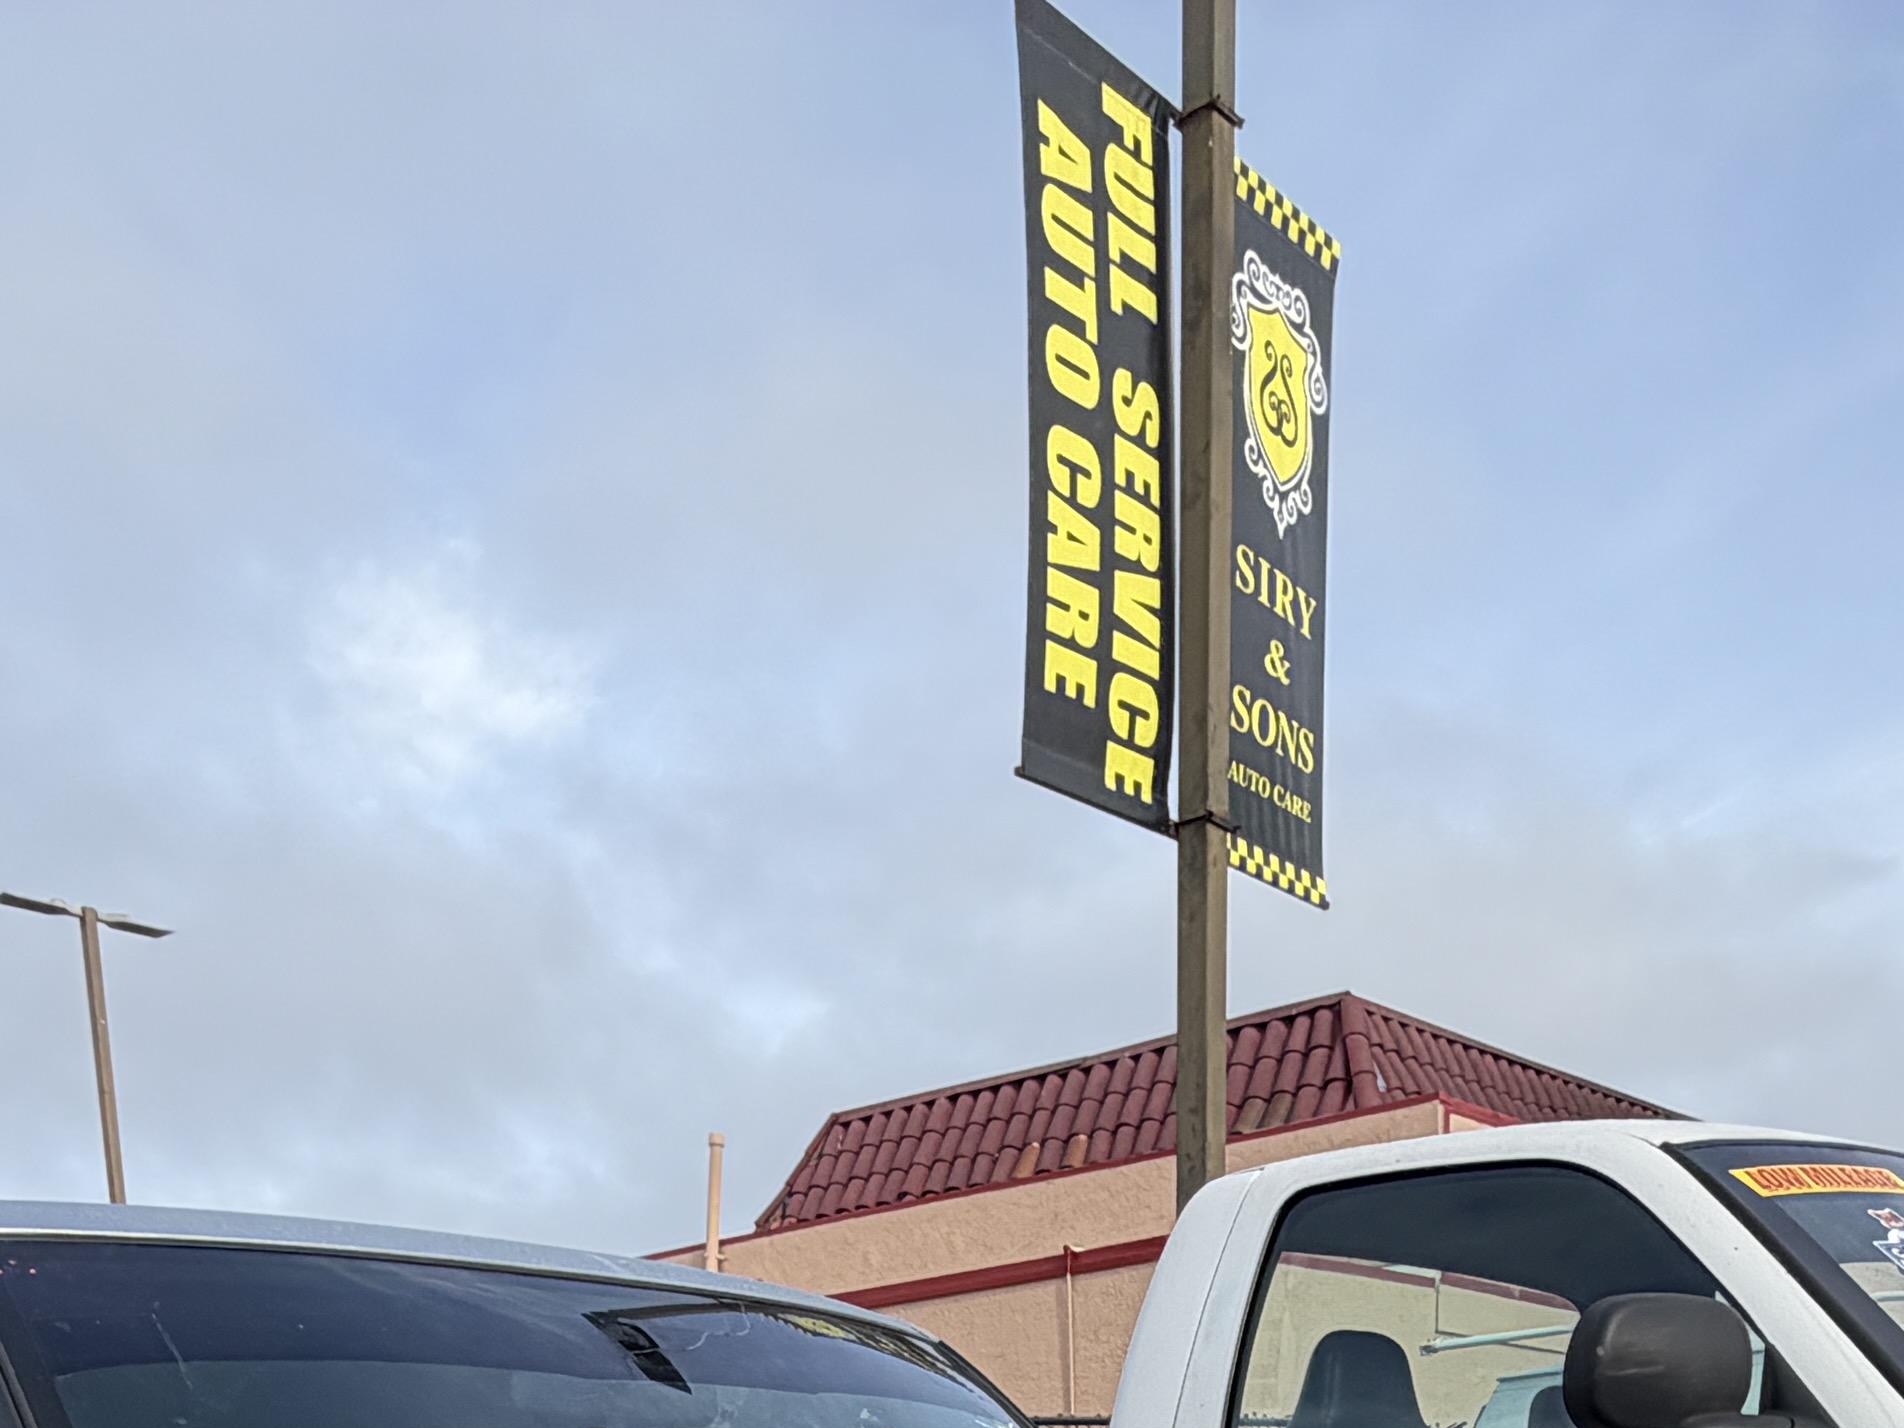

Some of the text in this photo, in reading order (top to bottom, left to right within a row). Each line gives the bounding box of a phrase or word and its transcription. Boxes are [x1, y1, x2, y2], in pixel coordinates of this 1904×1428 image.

[1037, 98, 1102, 710] AUTO CARE
[1101, 81, 1161, 805] FULL SERVICE
[1234, 544, 1318, 640] SIRY
[1263, 638, 1291, 686] &
[1229, 684, 1315, 775] SONS
[1227, 759, 1313, 824] AUTO CARE
[1744, 1166, 1812, 1191] LOW
